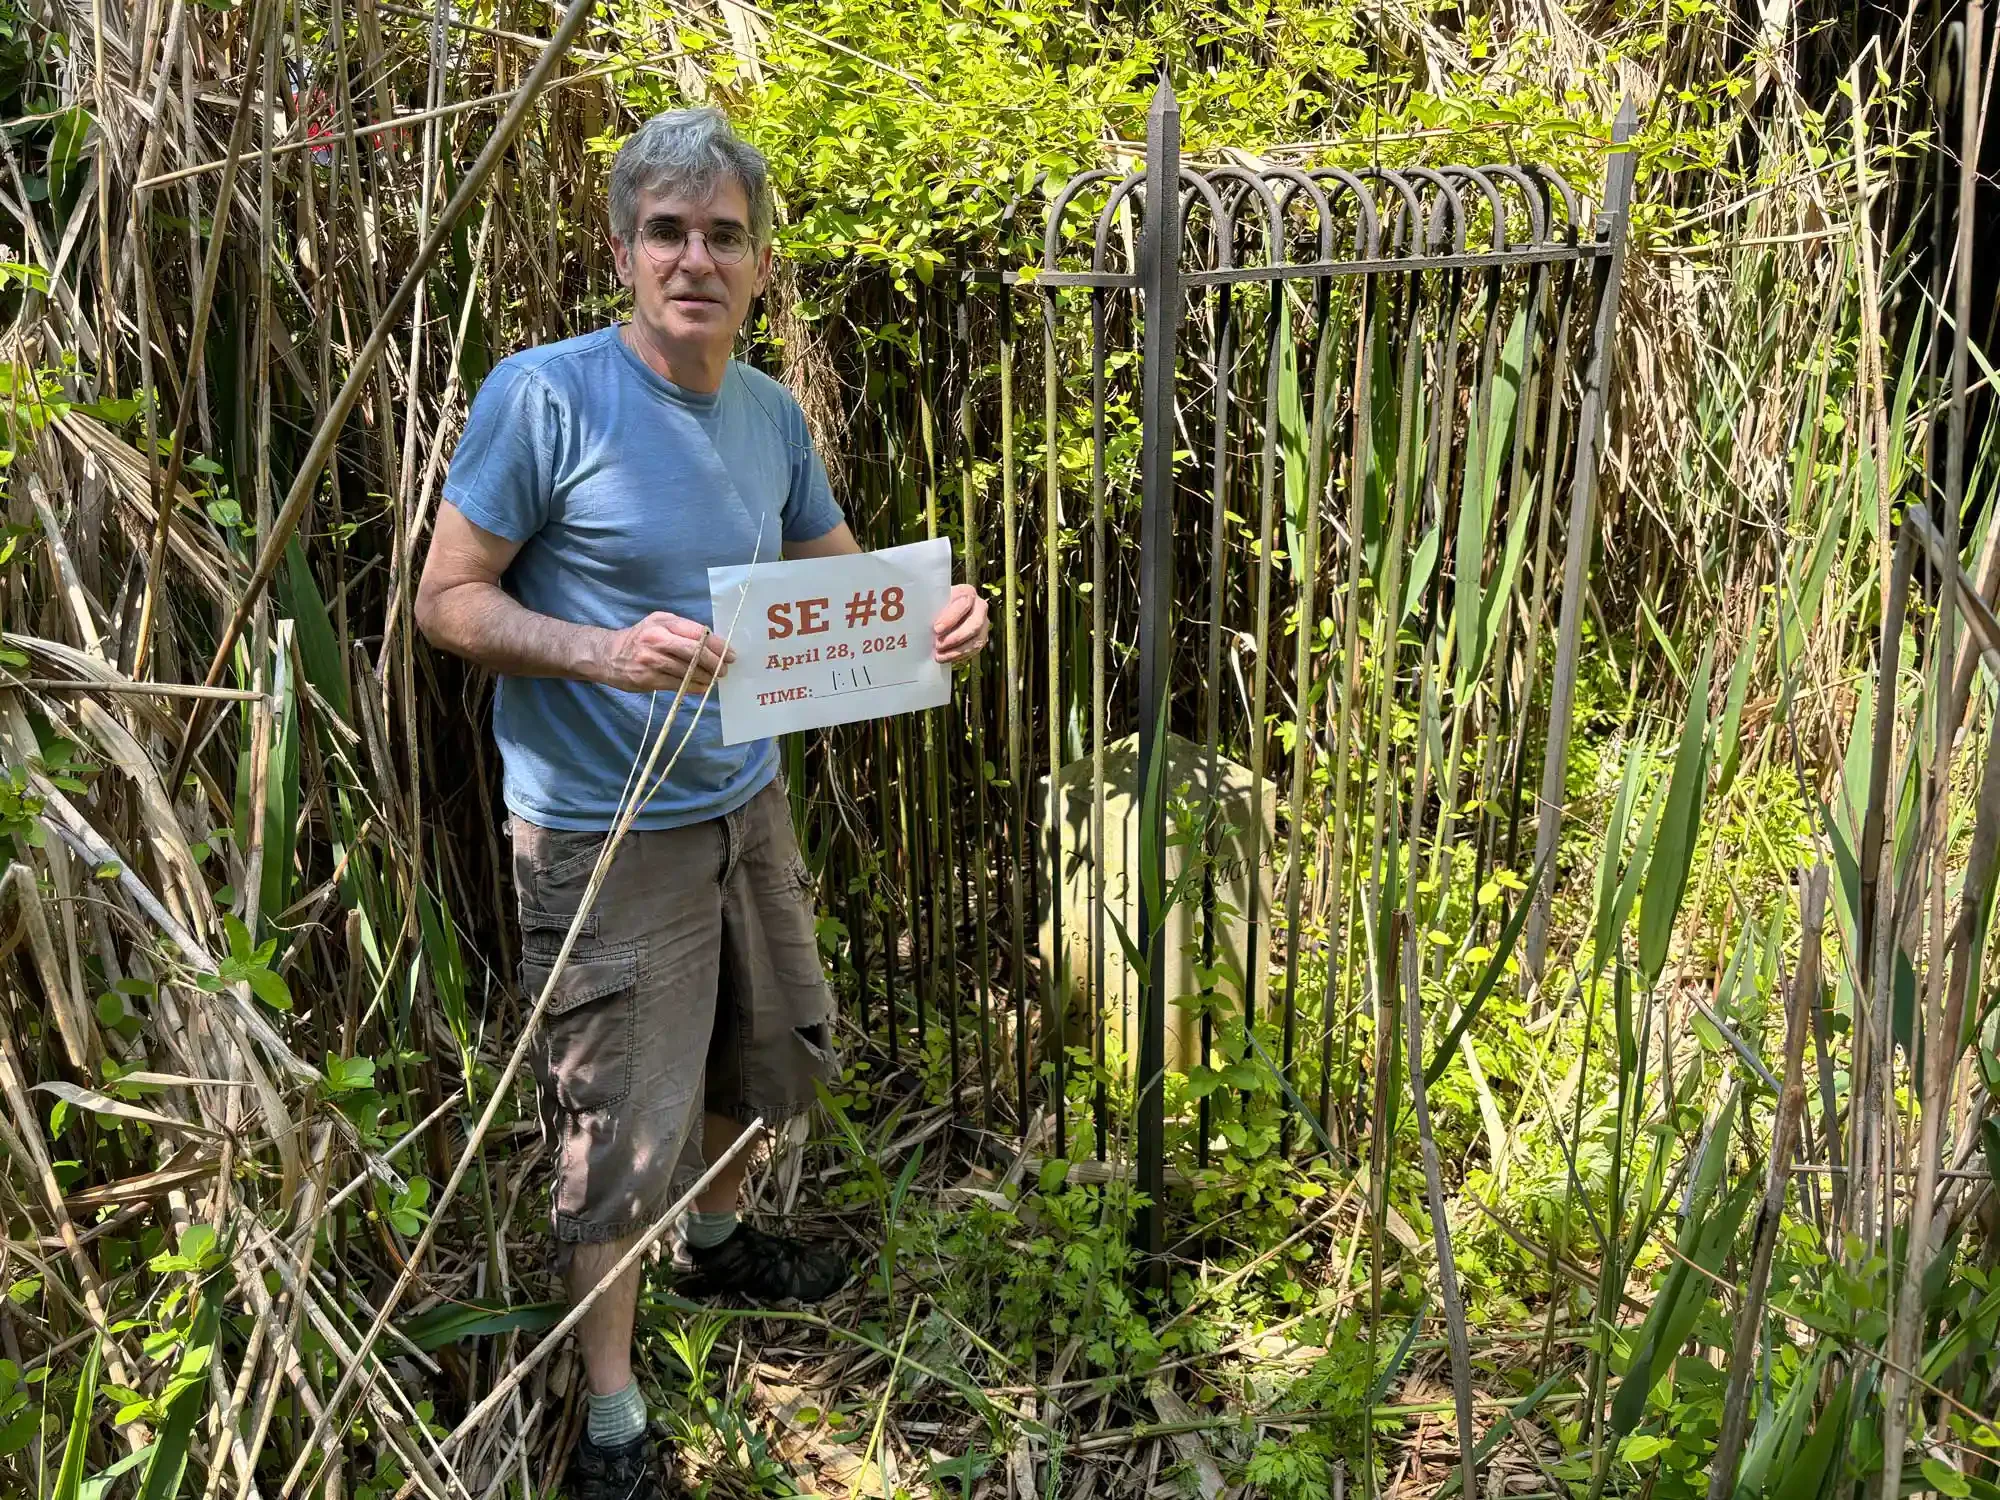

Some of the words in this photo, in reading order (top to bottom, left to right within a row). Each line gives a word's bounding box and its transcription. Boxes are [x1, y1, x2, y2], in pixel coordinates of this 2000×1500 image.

[767, 597, 830, 641] SE
[844, 586, 905, 629] #8
[765, 648, 820, 671] April
[826, 643, 855, 660] 28,
[862, 633, 908, 655] 2024
